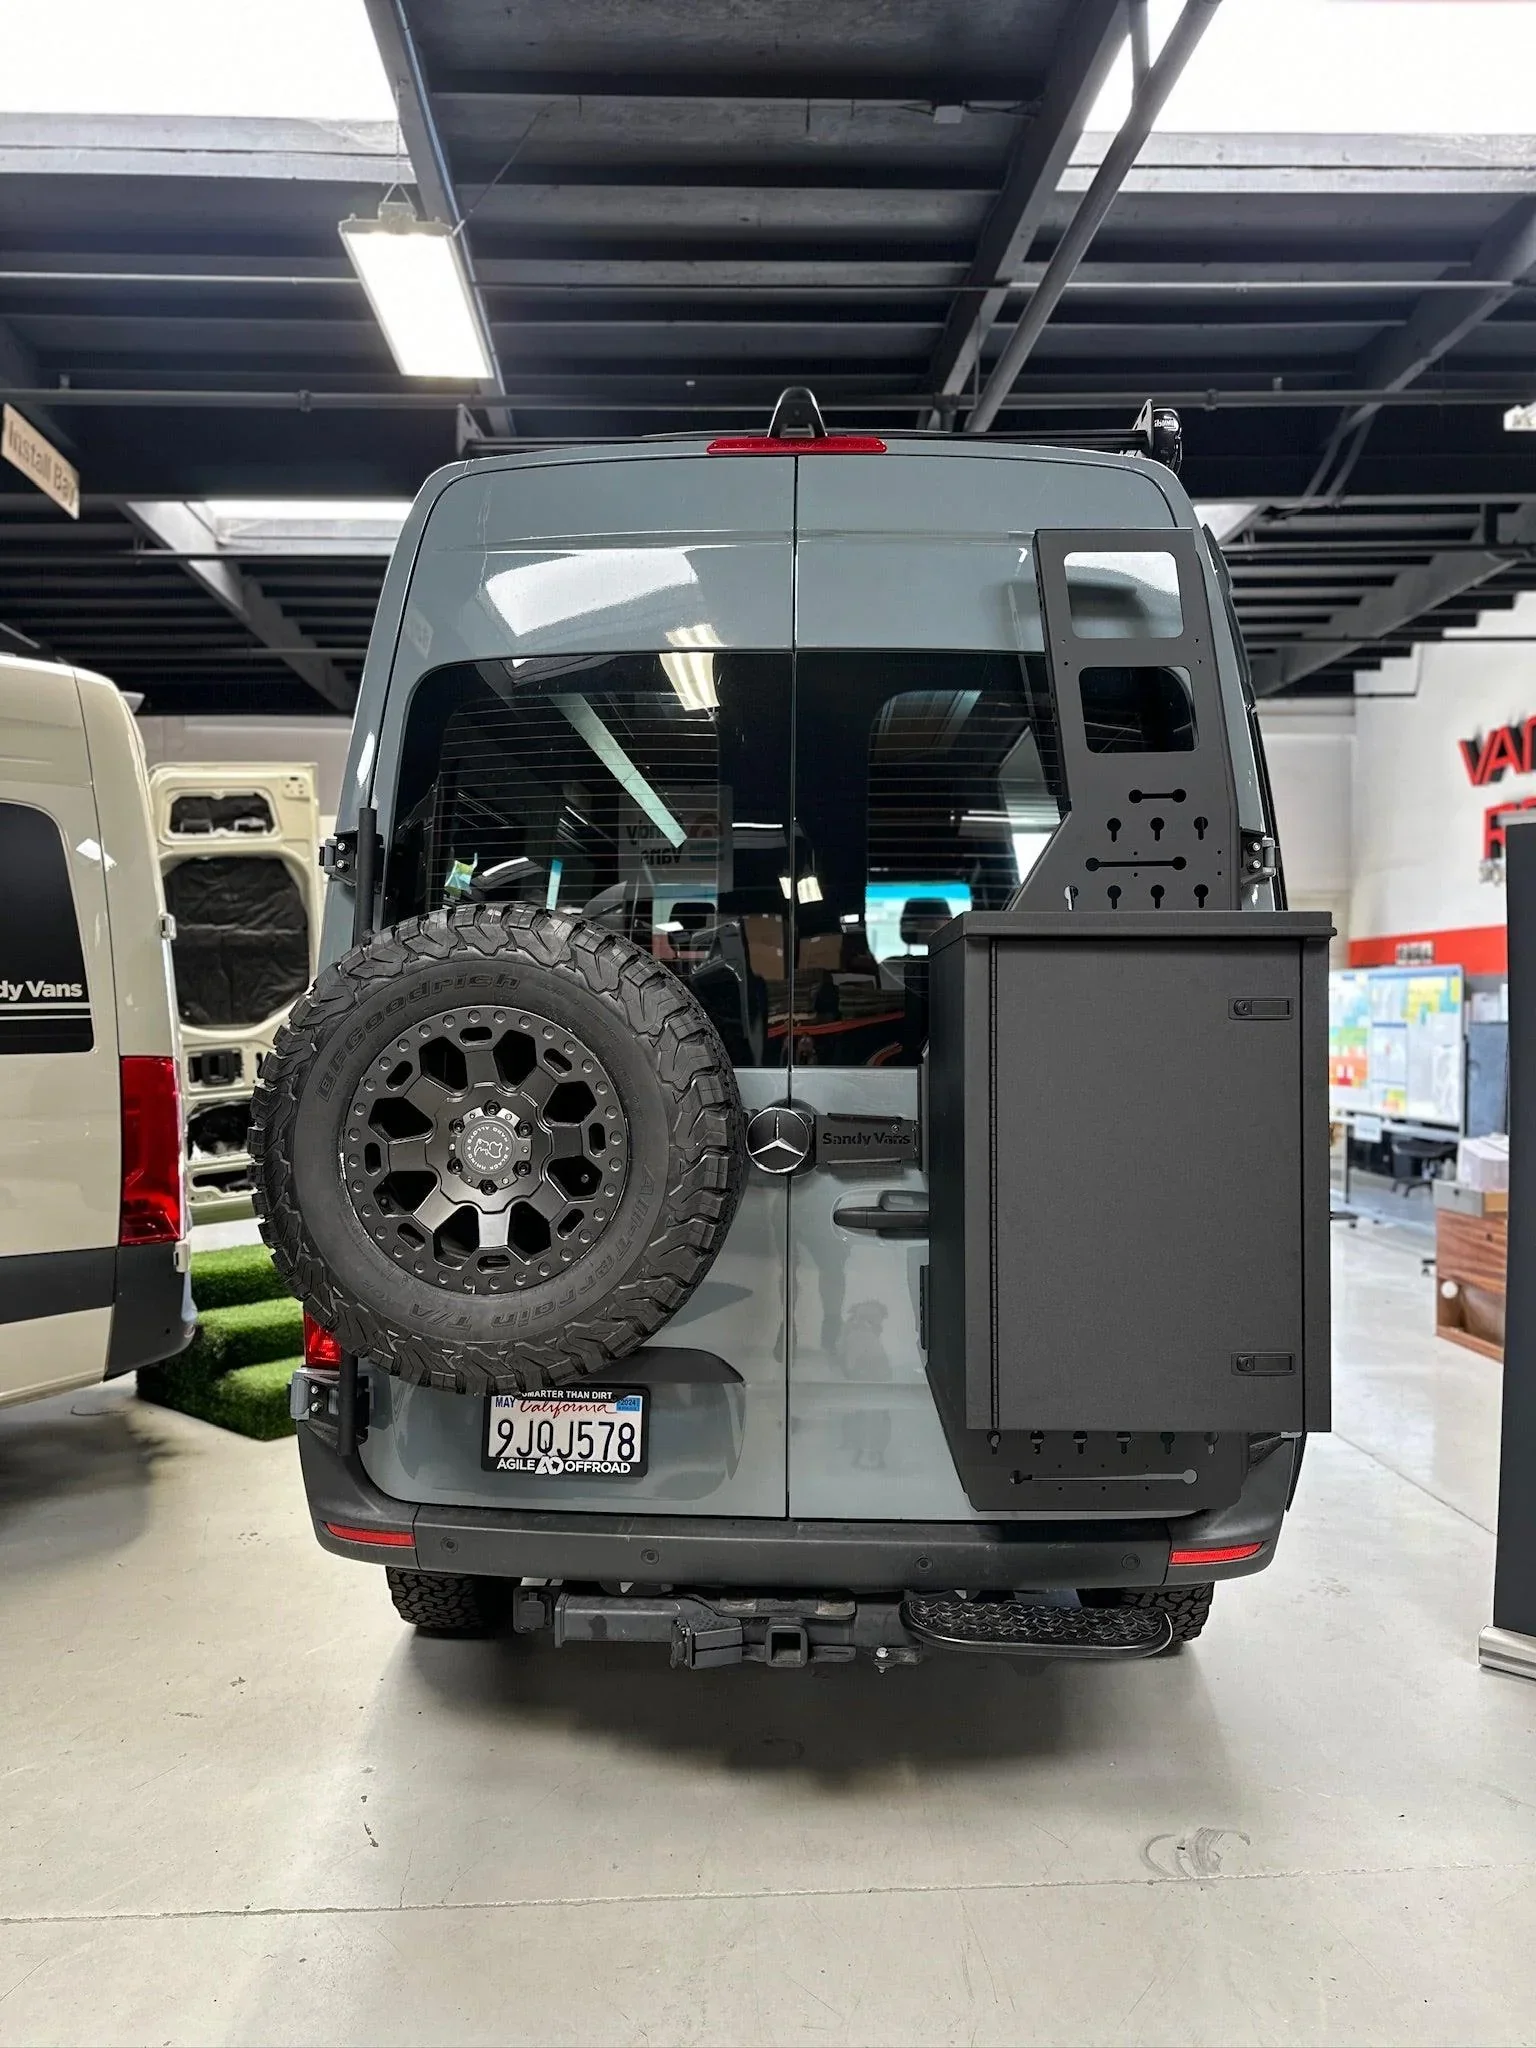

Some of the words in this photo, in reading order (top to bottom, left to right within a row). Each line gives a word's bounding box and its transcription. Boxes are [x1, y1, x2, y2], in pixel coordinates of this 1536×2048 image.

[9, 420, 52, 483] Install
[53, 462, 76, 508] Bay
[25, 980, 83, 998] Vans
[315, 973, 520, 1102] BFGoodrich
[822, 1131, 871, 1148] Sandy
[873, 1132, 912, 1145] Vans
[468, 1153, 486, 1170] RHINO
[489, 1154, 508, 1170] BLACK
[566, 1391, 590, 1399] THAN
[591, 1391, 613, 1400] DIRT
[495, 1396, 515, 1408] MAY
[519, 1400, 616, 1418] California
[495, 1419, 636, 1461] 9JQJ578
[497, 1457, 535, 1471] AGILE
[565, 1460, 631, 1474] OFFROAD
